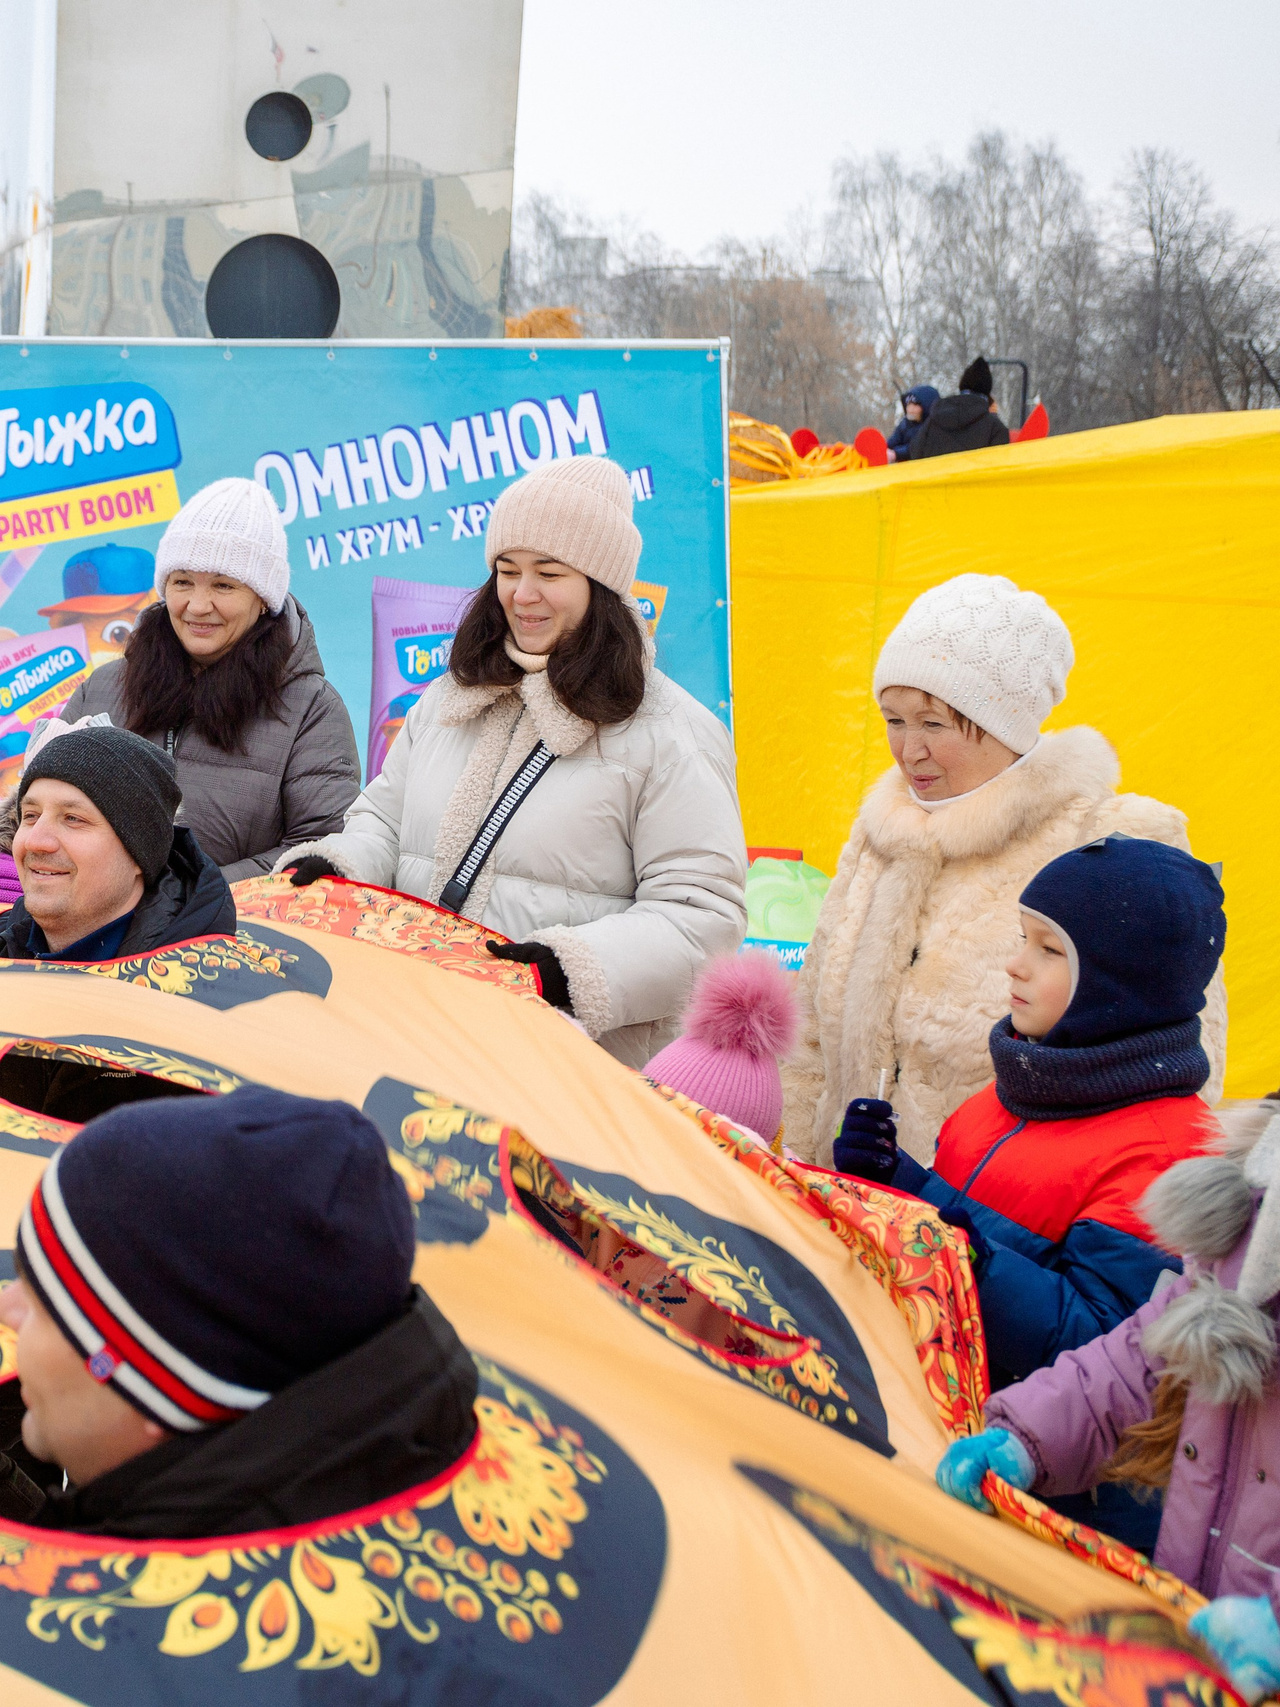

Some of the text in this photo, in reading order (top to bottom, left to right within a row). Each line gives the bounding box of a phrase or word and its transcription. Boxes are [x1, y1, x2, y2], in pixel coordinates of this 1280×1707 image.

[254, 390, 609, 526] ОМНОМНОМ
[306, 534, 331, 570] И
[336, 516, 423, 565] ХРУМ
[28, 690, 57, 716] PARTY
